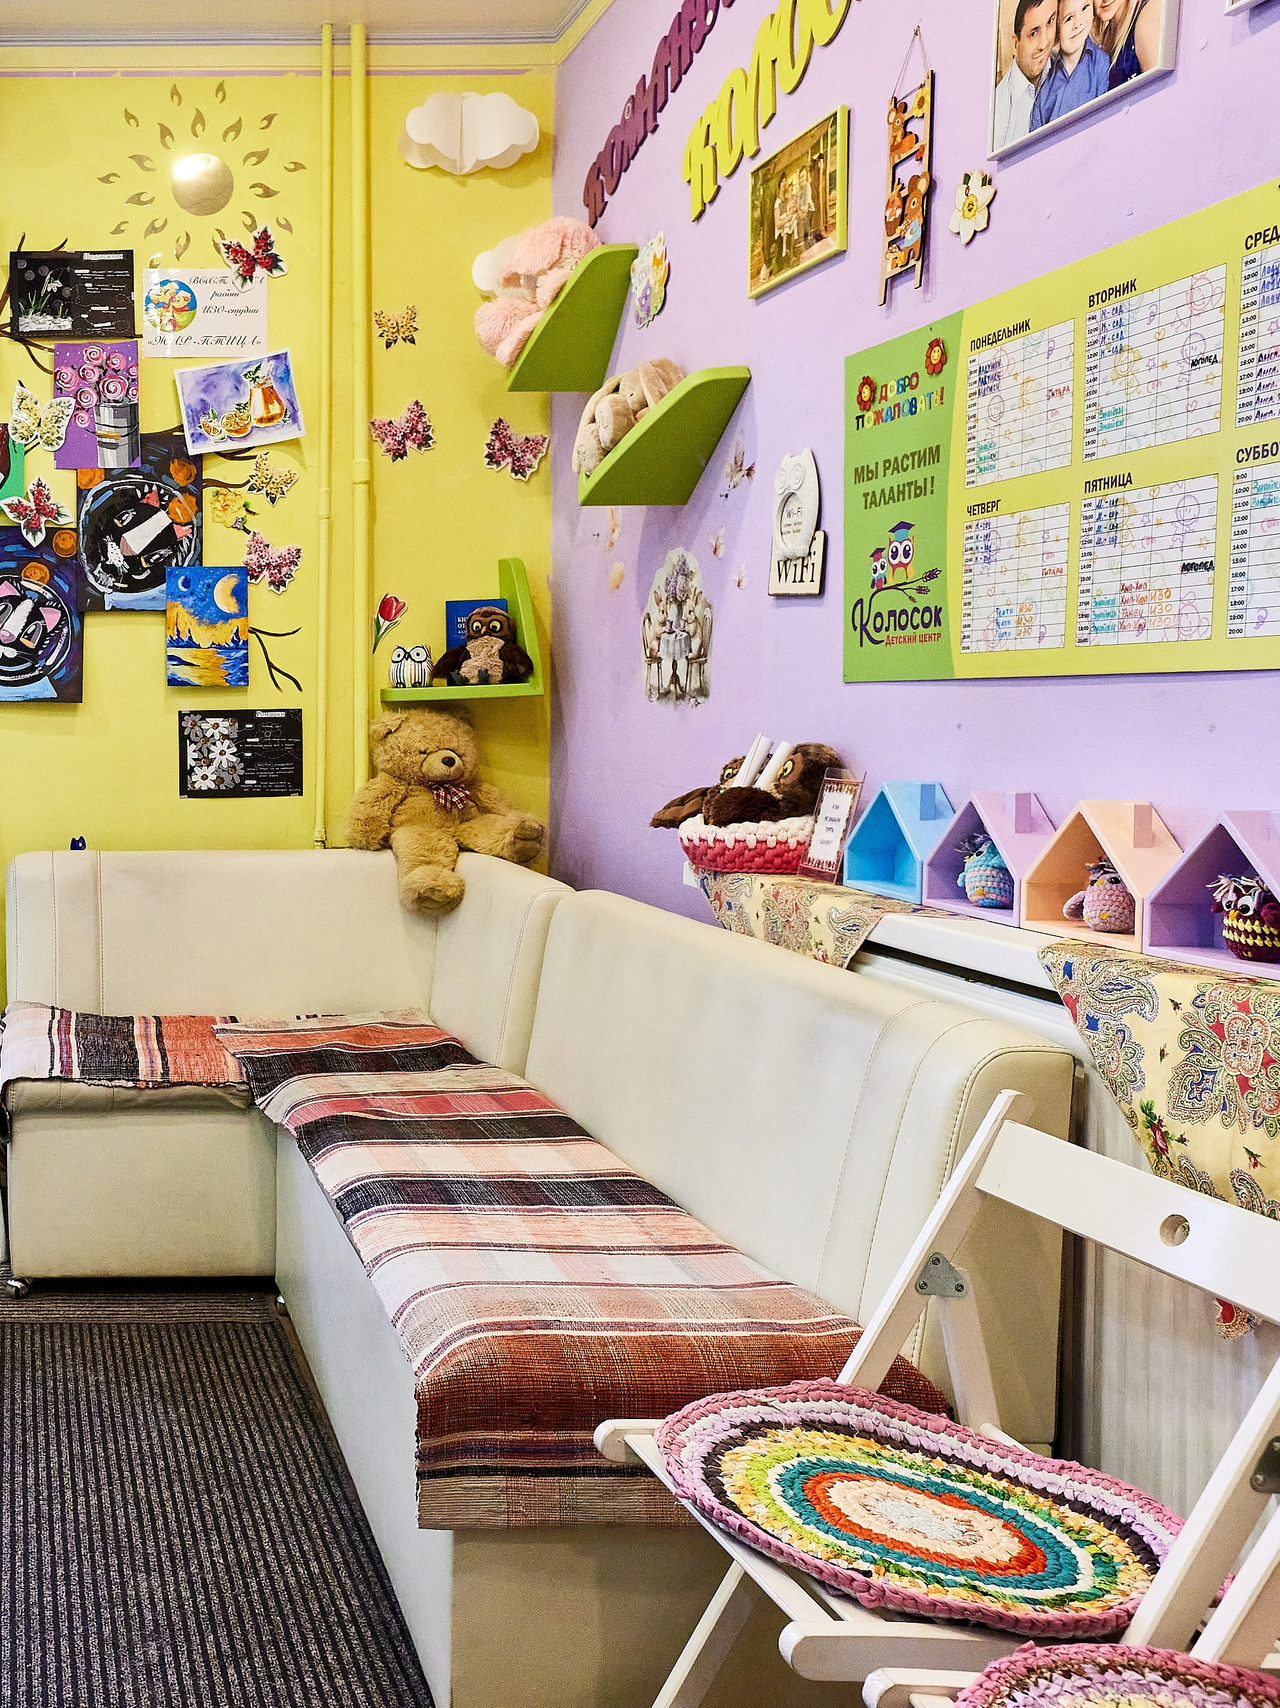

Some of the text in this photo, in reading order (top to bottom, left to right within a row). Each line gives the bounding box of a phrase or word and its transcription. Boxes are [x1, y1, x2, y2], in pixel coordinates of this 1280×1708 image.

[1244, 257, 1257, 266] 9:00
[1244, 271, 1258, 281] 10:00
[210, 289, 240, 300] работ
[1088, 278, 1137, 308] ВТОРНИК
[1243, 285, 1258, 295] 11:00
[1242, 300, 1258, 310] 12:00
[202, 306, 259, 317] ИЗО-студии
[1242, 314, 1257, 324] 13:00
[970, 319, 1031, 352] ПОНЕДЕЛЬНИК
[1241, 328, 1256, 338] 14:00
[1240, 343, 1255, 352] 15:00
[1240, 358, 1254, 366] 16:00
[1239, 372, 1254, 381] 17:00
[878, 371, 919, 404] ДОБРО
[1239, 386, 1254, 395] 18:00
[855, 386, 945, 430] ПОЖАЛОВАТЬ!
[1238, 400, 1253, 409] 19:00
[1238, 414, 1252, 423] 20:00
[1236, 441, 1280, 464] СУББО
[854, 444, 941, 485] МЫ РАСТИМ
[1084, 472, 1132, 494] ПЯТНИЦА
[1235, 486, 1249, 494] 10:00
[967, 499, 1001, 516] ЧЕТВЕРГ
[777, 551, 816, 584] WiFi
[1150, 588, 1171, 601] ИЗО
[1150, 604, 1172, 614] ИЗО
[1149, 617, 1171, 627] ИЗО
